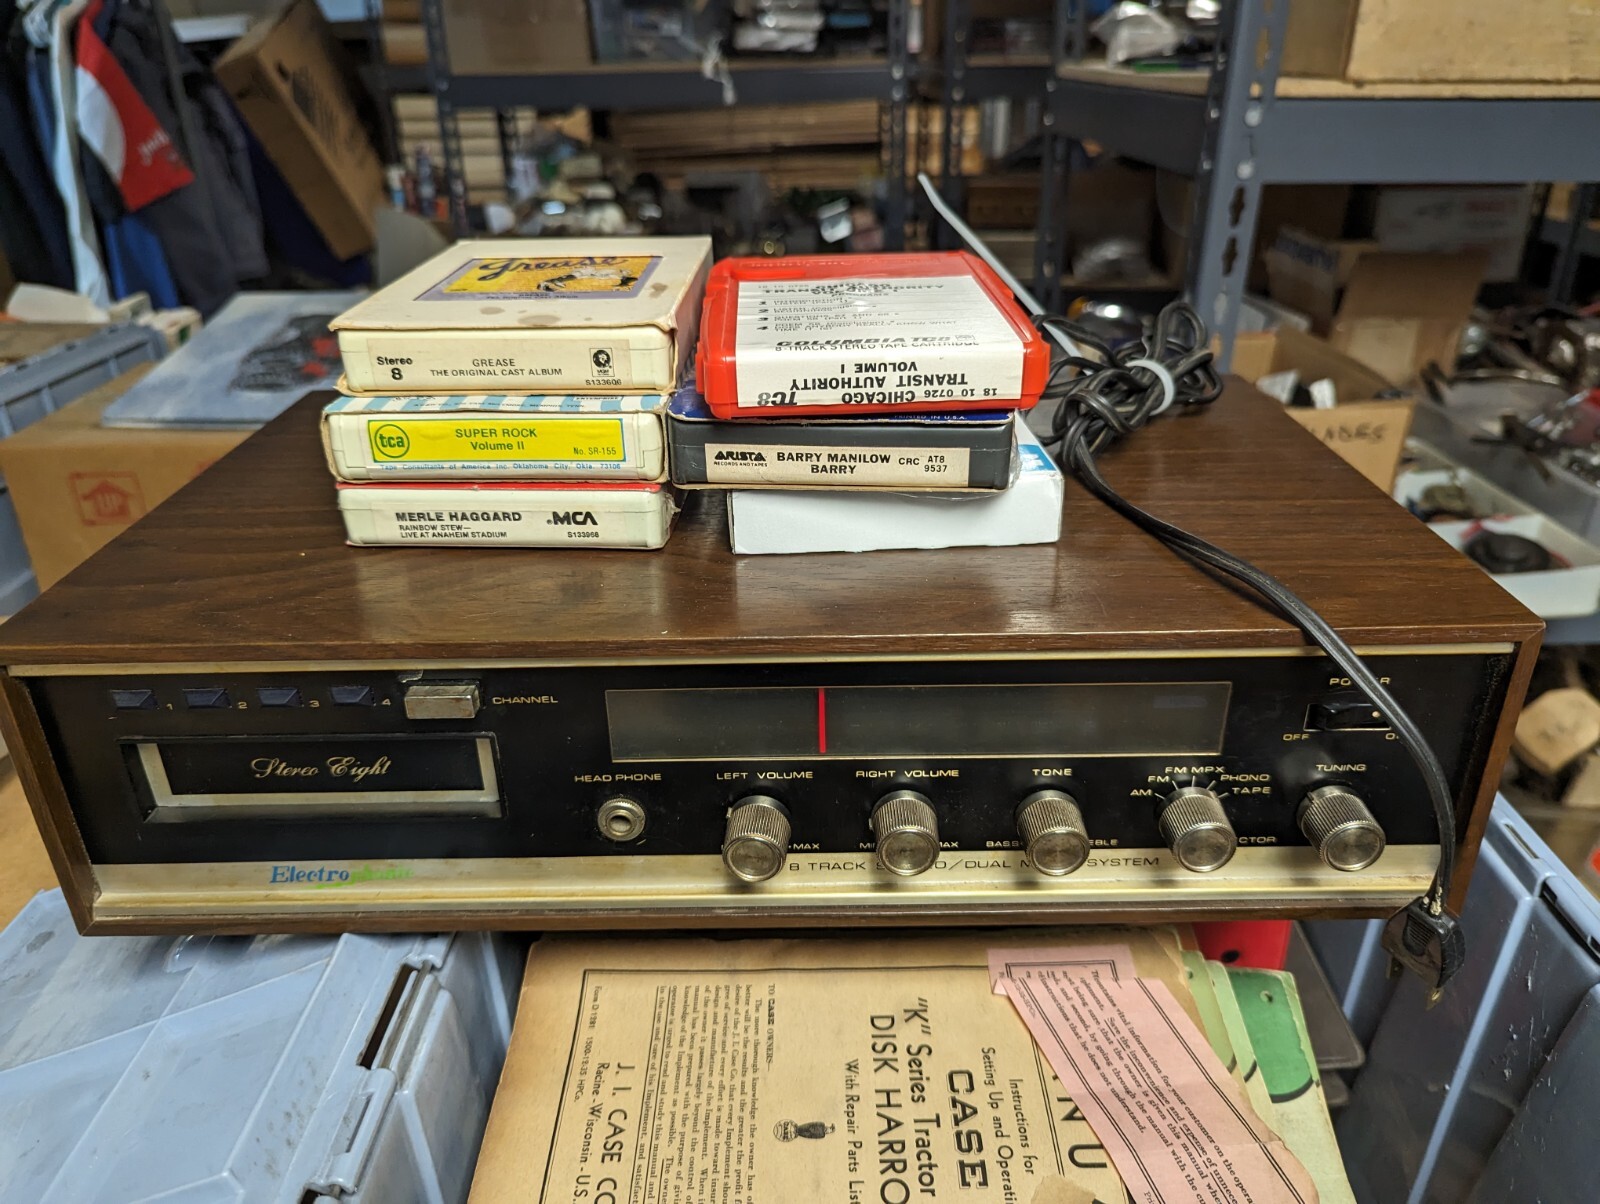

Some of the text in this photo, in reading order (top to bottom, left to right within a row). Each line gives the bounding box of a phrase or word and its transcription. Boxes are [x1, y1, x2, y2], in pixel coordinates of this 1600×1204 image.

[376, 356, 413, 366] Stereo
[472, 359, 516, 367] GREASE
[430, 369, 449, 377] THE
[501, 368, 525, 376] CAST
[528, 368, 563, 376] ALBUM
[855, 362, 918, 373] VOLUME
[391, 367, 403, 380] 8
[790, 373, 968, 391] TRANSIT AUTHORITY
[842, 388, 997, 404] 18 10 0726 CHICAGO
[455, 428, 537, 438] SUPER ROCK
[379, 433, 405, 449] tca
[471, 441, 525, 451] Volume II
[573, 447, 616, 455] No. SR-155
[714, 451, 766, 461] ARISTA
[777, 452, 945, 466] BARRY MANILOW CRC AT8
[811, 464, 857, 474] BARRY
[924, 464, 948, 473] 9537
[395, 511, 522, 522] MERLE HAGGARD
[1330, 677, 1391, 686] POR
[238, 701, 248, 709] 2
[309, 700, 320, 708] 3
[381, 698, 391, 706] 4
[493, 694, 559, 705] CHANNEL
[166, 703, 173, 711] 1
[1282, 733, 1309, 741] OFF
[251, 756, 393, 783] Stereo Eight
[855, 769, 960, 778] RIGHT VOLUME
[1032, 768, 1072, 776] TONE
[1165, 765, 1225, 774] FM MPX
[1315, 764, 1367, 772] TUNING
[574, 773, 662, 782] HEAD PHONE
[716, 771, 814, 780] LEFT VOLUME
[1147, 775, 1169, 784] FM
[1220, 773, 1270, 782] PHONO
[1130, 789, 1152, 797] AM
[1232, 786, 1271, 795] TAPE
[1237, 836, 1277, 844] CTOR
[793, 842, 820, 850] MAX
[789, 862, 800, 871] 8
[807, 861, 867, 870] TRACK
[1087, 857, 1160, 867] SYSTEM
[768, 984, 775, 994] TO
[870, 1015, 899, 1073] DISK
[616, 1062, 635, 1075] J.
[981, 1047, 995, 1085] Setting
[592, 1062, 610, 1095] Racine
[845, 1059, 859, 1089] With
[906, 1044, 932, 1103] Series
[1128, 1027, 1215, 1144] information customer
[612, 1087, 632, 1096] I.
[749, 1077, 760, 1120] knowledge
[988, 1092, 1004, 1109] Up
[1130, 1050, 1208, 1156] inconvenience expense
[844, 1095, 860, 1134] Repair
[1111, 1088, 1146, 1133] understand.
[946, 1070, 988, 1189] CASE
[993, 1116, 1010, 1138] and
[1009, 1079, 1038, 1174] Instructions for
[579, 1103, 603, 1163] Wisconsin
[601, 1109, 627, 1163] CASE
[701, 1108, 713, 1160] Implement.
[723, 1128, 734, 1179] Implement
[848, 1141, 862, 1172] Parts
[913, 1113, 941, 1197] Tractor
[1181, 1142, 1208, 1180] manual
[734, 1169, 743, 1194] profit
